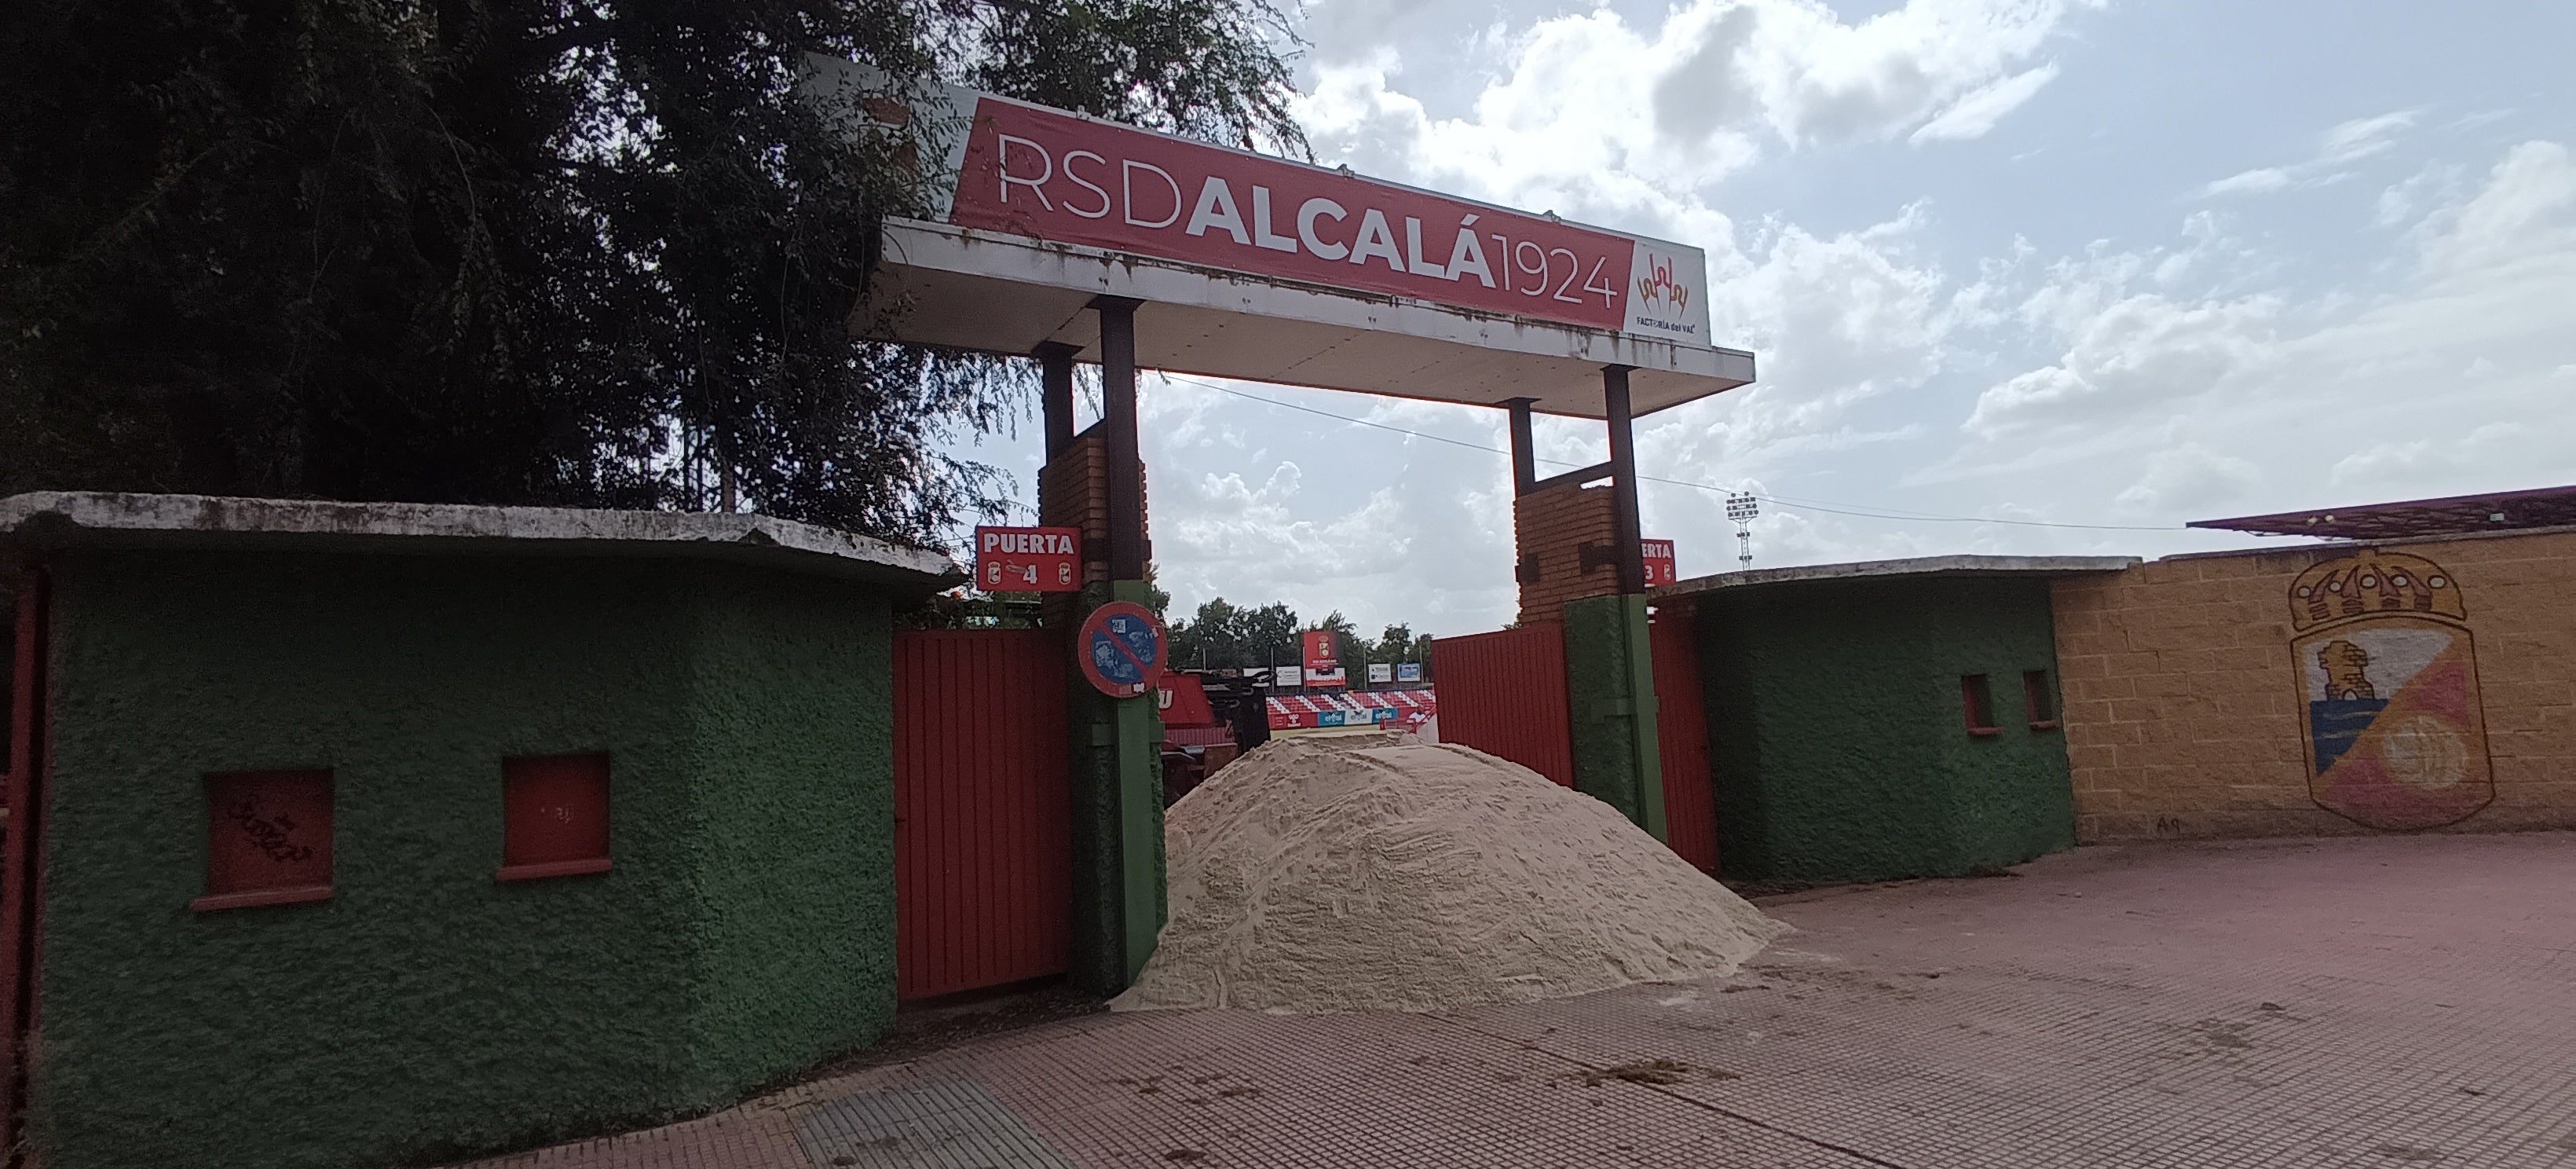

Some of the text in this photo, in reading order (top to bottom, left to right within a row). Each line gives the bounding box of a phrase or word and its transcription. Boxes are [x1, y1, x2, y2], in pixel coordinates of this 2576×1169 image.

[983, 533, 1074, 555] PUERTA
[1641, 543, 1672, 559] ERTA
[1023, 564, 1037, 584] 4
[1645, 565, 1654, 580] 3
